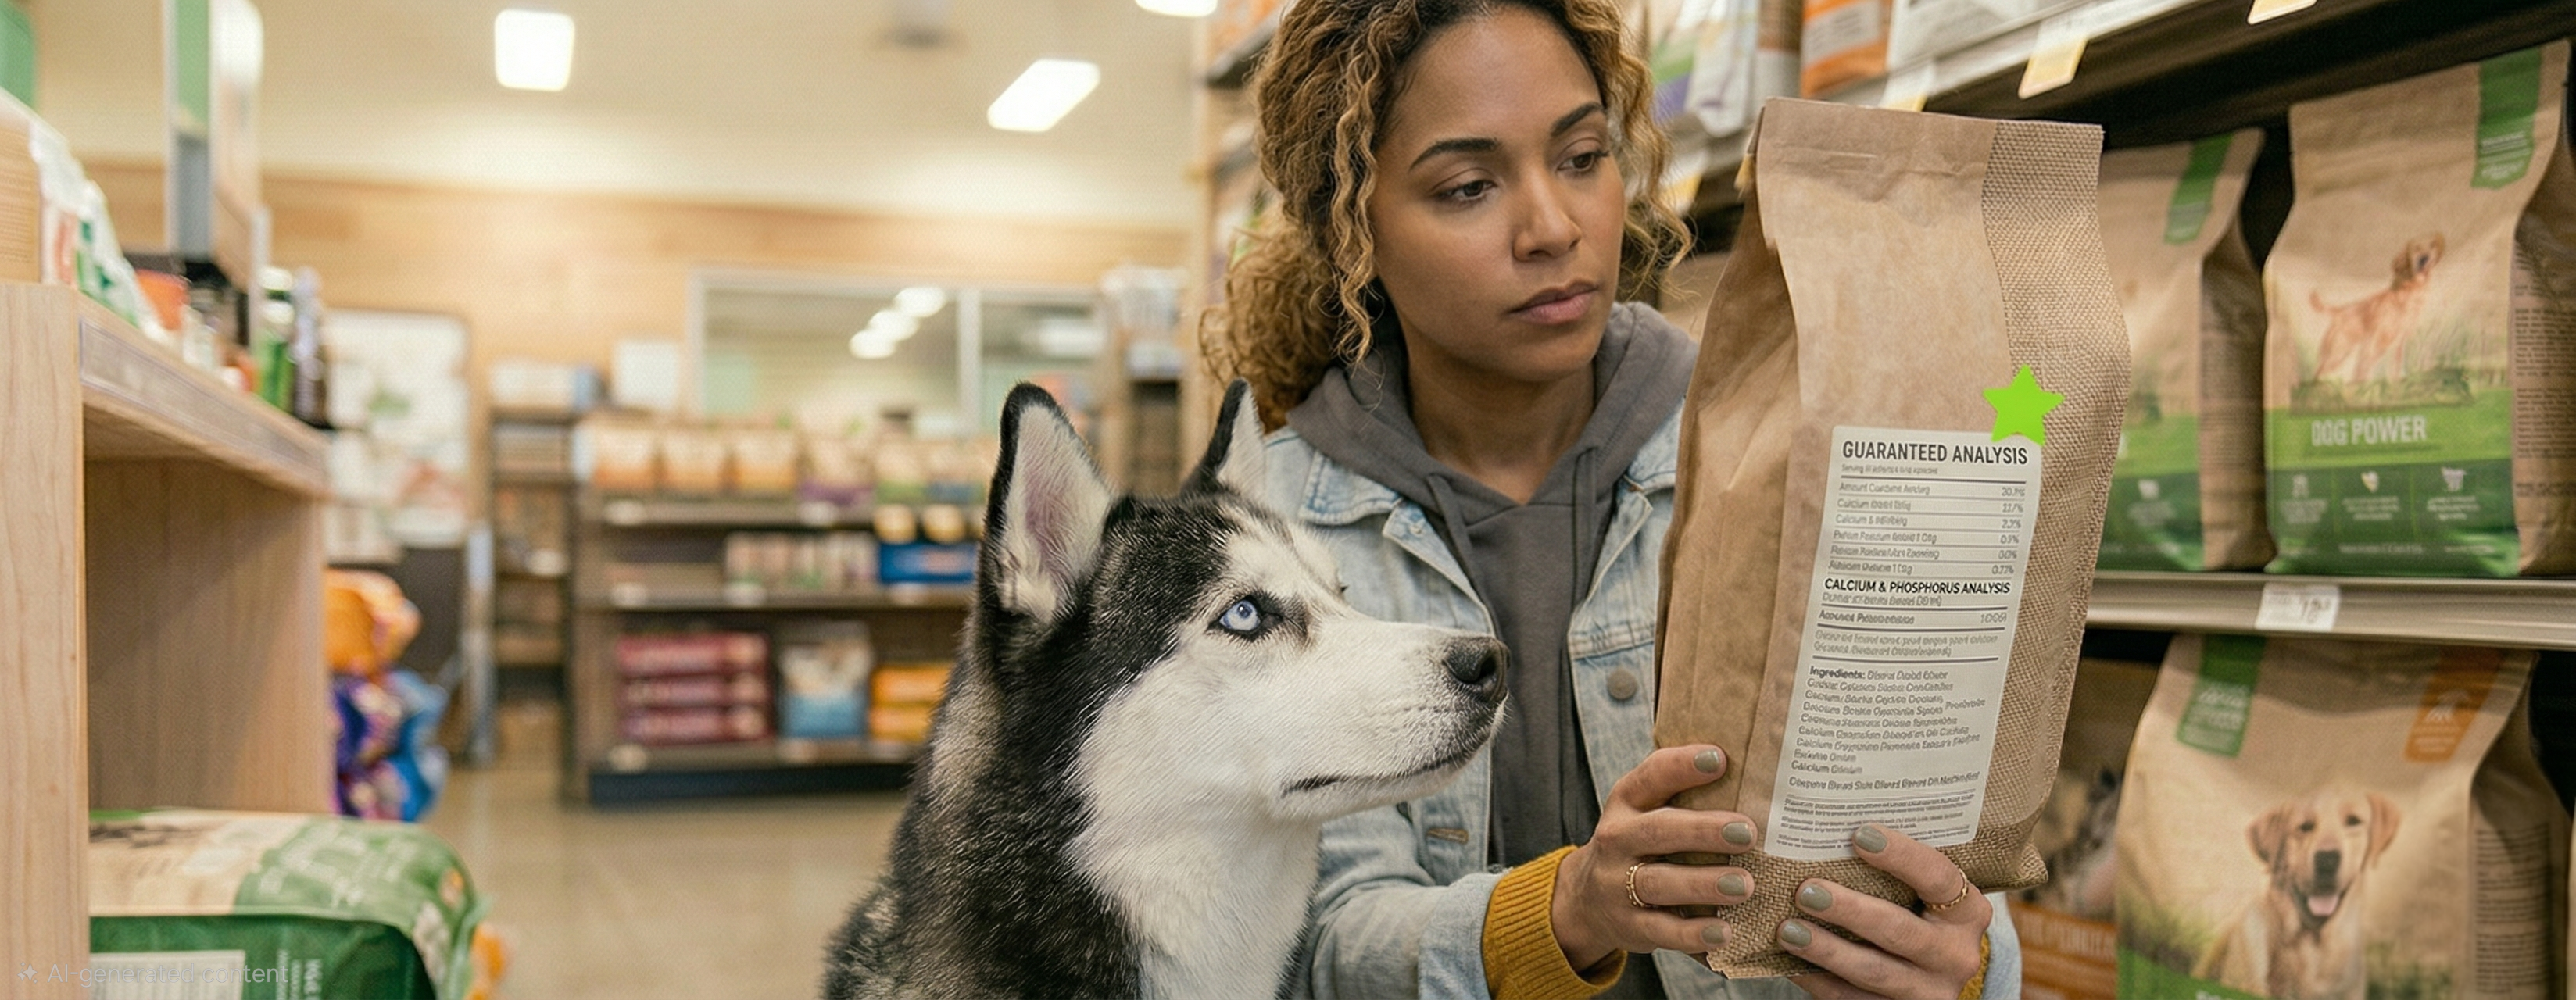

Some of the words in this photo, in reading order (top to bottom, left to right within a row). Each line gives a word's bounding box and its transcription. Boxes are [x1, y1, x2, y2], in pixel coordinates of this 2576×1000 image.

[2351, 416, 2427, 445] POWER
[1842, 441, 1948, 462] GUARANTEED
[1952, 445, 2028, 465] ANALYSIS
[1824, 578, 1876, 592] CALCIUM
[1879, 583, 1887, 593] &
[1889, 581, 1959, 594] PHOSPHORUS
[1961, 582, 2011, 594] ANALYSIS
[1809, 666, 1866, 680] Ingredients:
